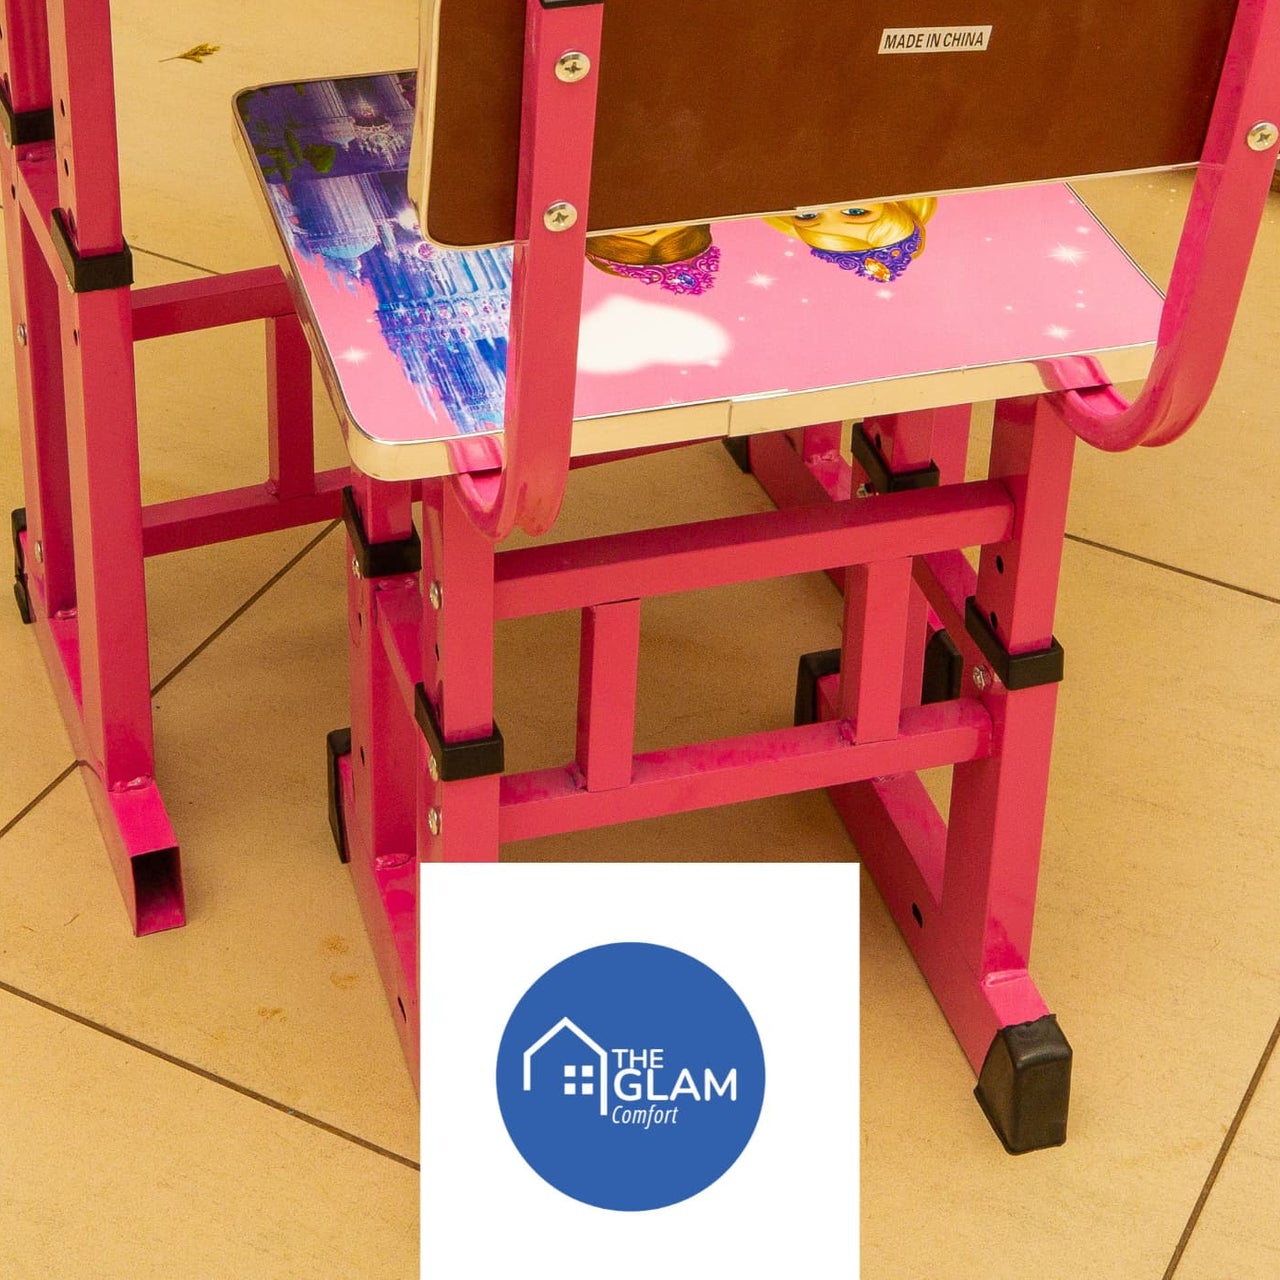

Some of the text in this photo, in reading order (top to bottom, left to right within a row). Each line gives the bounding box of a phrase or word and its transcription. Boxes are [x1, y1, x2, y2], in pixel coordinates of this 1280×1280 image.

[884, 31, 984, 49] MADE IN CHINA
